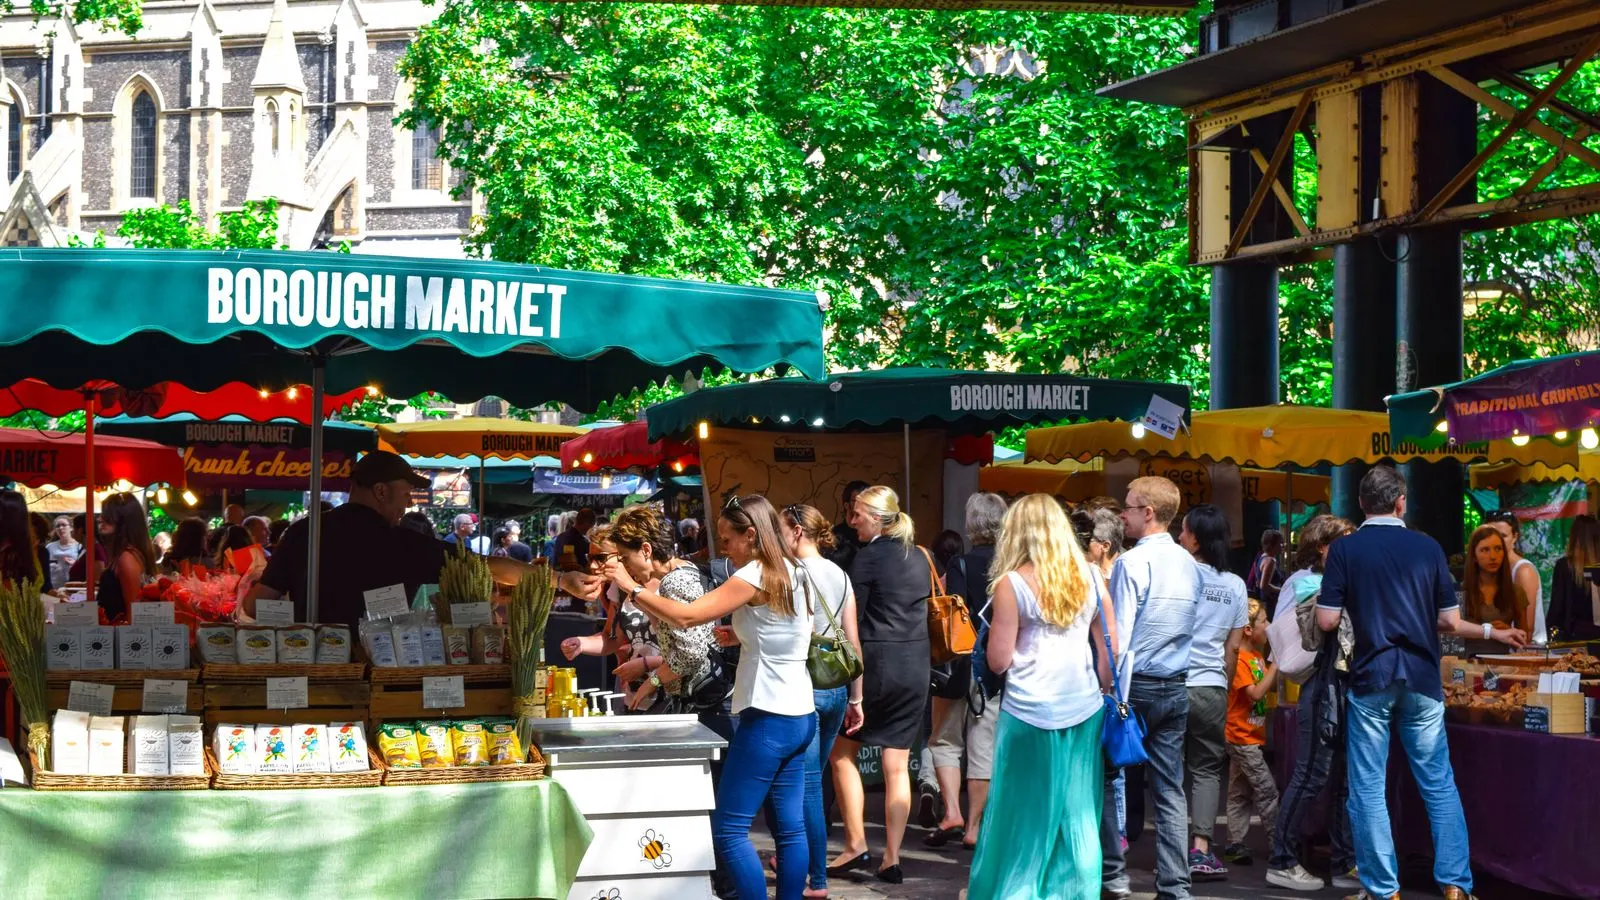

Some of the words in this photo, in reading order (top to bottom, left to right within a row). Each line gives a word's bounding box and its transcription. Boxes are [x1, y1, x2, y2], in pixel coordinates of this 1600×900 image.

[207, 267, 395, 329] BOROUGH
[405, 275, 567, 339] MARKET
[950, 384, 1024, 411] BOROUGH
[1027, 384, 1091, 411] MARKET
[1454, 393, 1539, 416] TRADITIONAL
[186, 424, 241, 442] BOROUGH
[245, 426, 295, 444] MARKET
[482, 434, 532, 451] BOROUGH
[0, 449, 58, 473] ARKET
[255, 451, 352, 477] cheees
